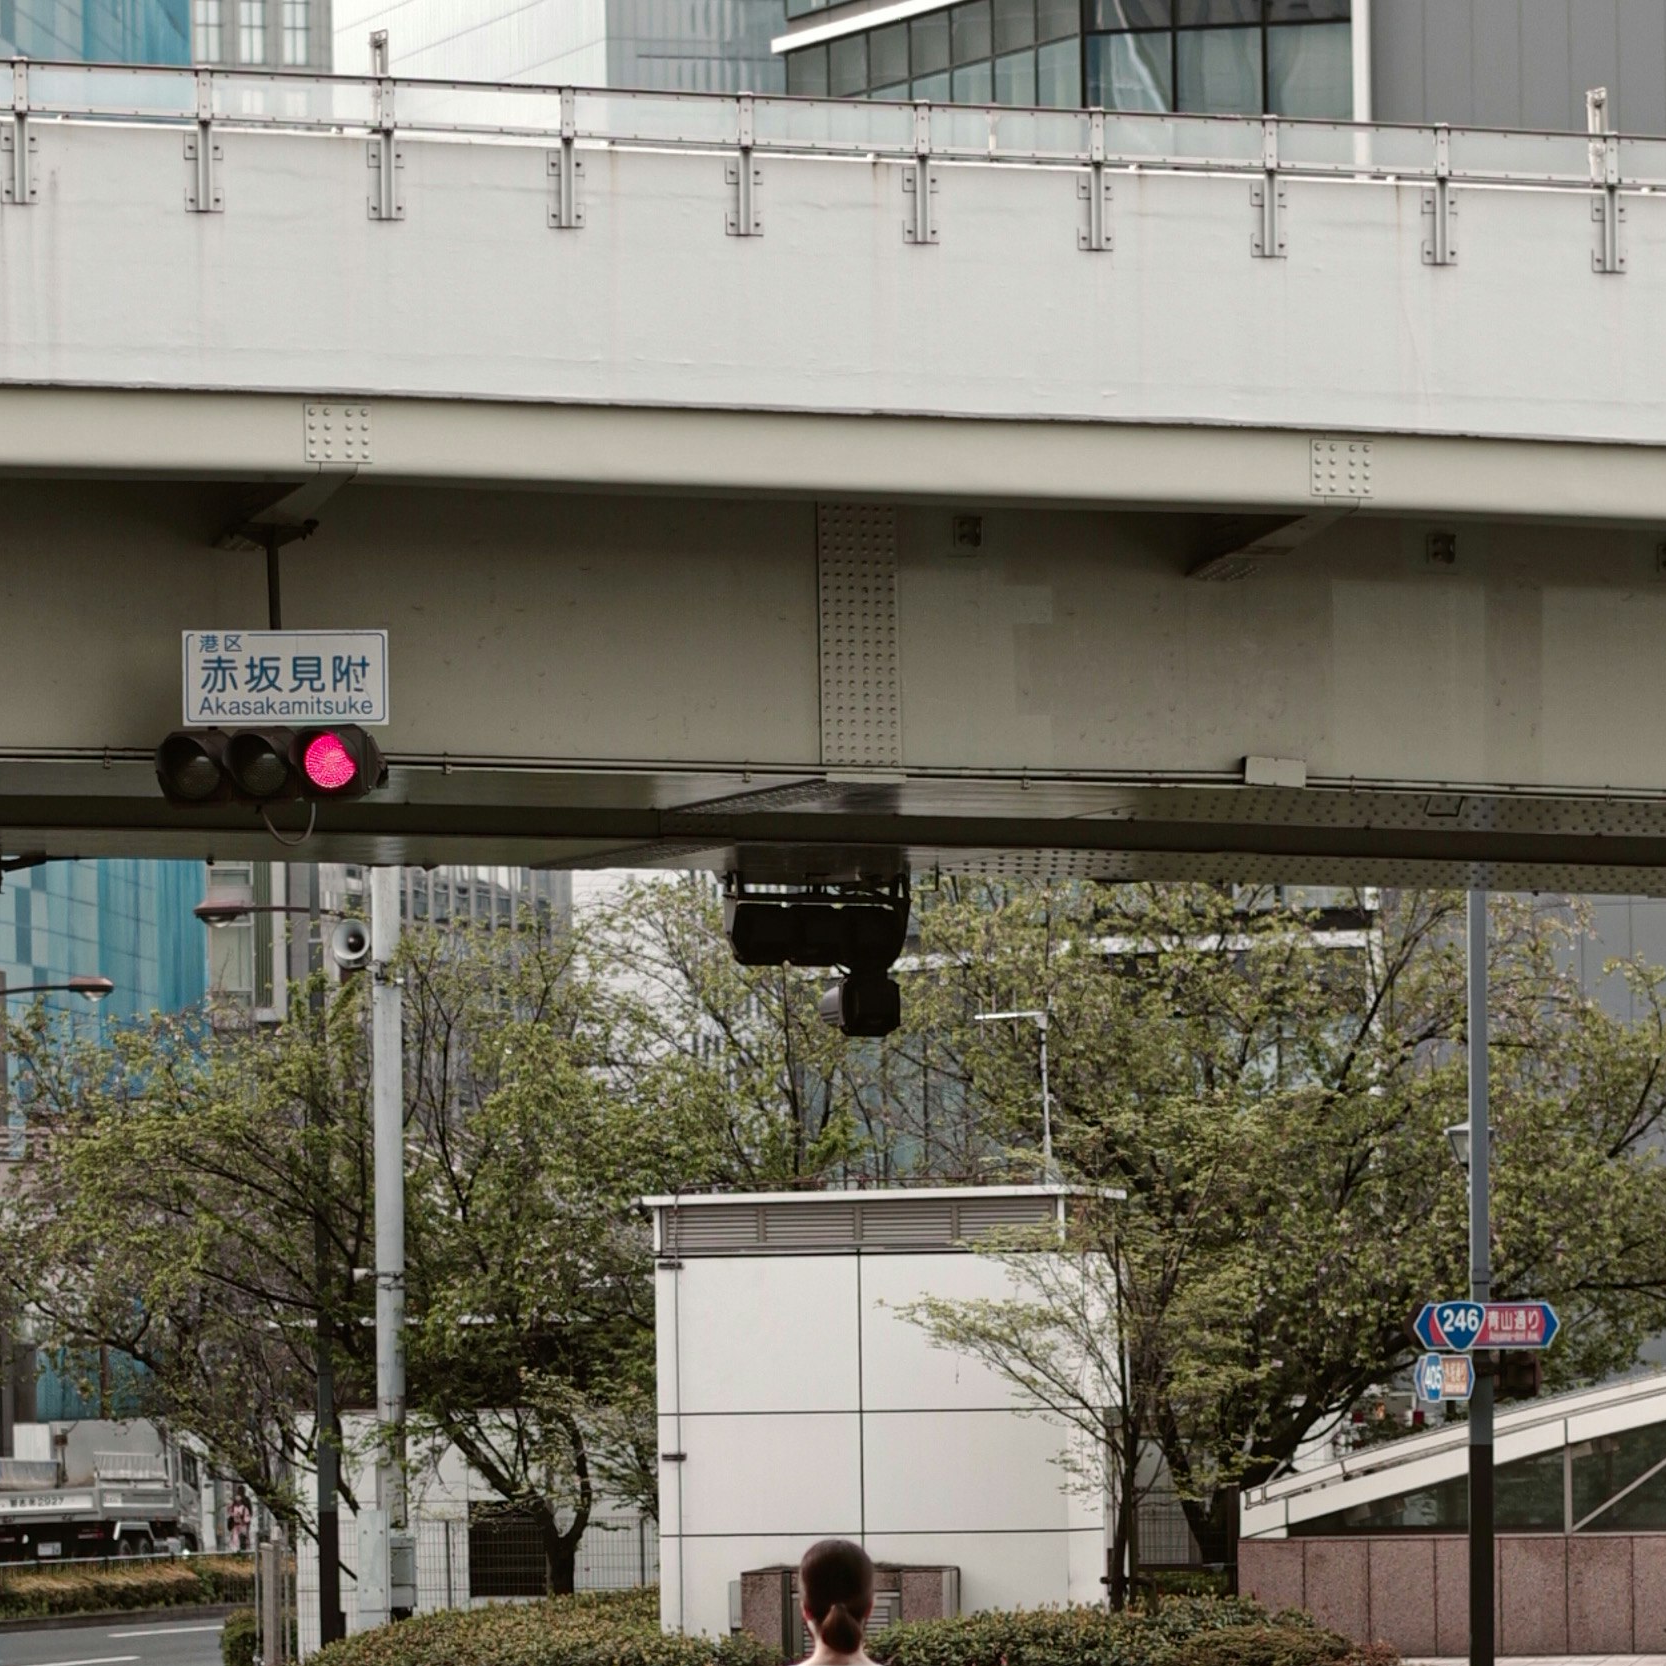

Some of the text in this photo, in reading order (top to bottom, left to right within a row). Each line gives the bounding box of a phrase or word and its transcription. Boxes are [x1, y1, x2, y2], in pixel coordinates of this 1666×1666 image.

[199, 634, 242, 653] 港区
[200, 655, 370, 694] 赤坂見附
[198, 696, 374, 716] Akasakamitsuke
[1443, 1308, 1480, 1333] 246
[1488, 1310, 1540, 1331] 青山通り
[1424, 1365, 1442, 1390] 405
